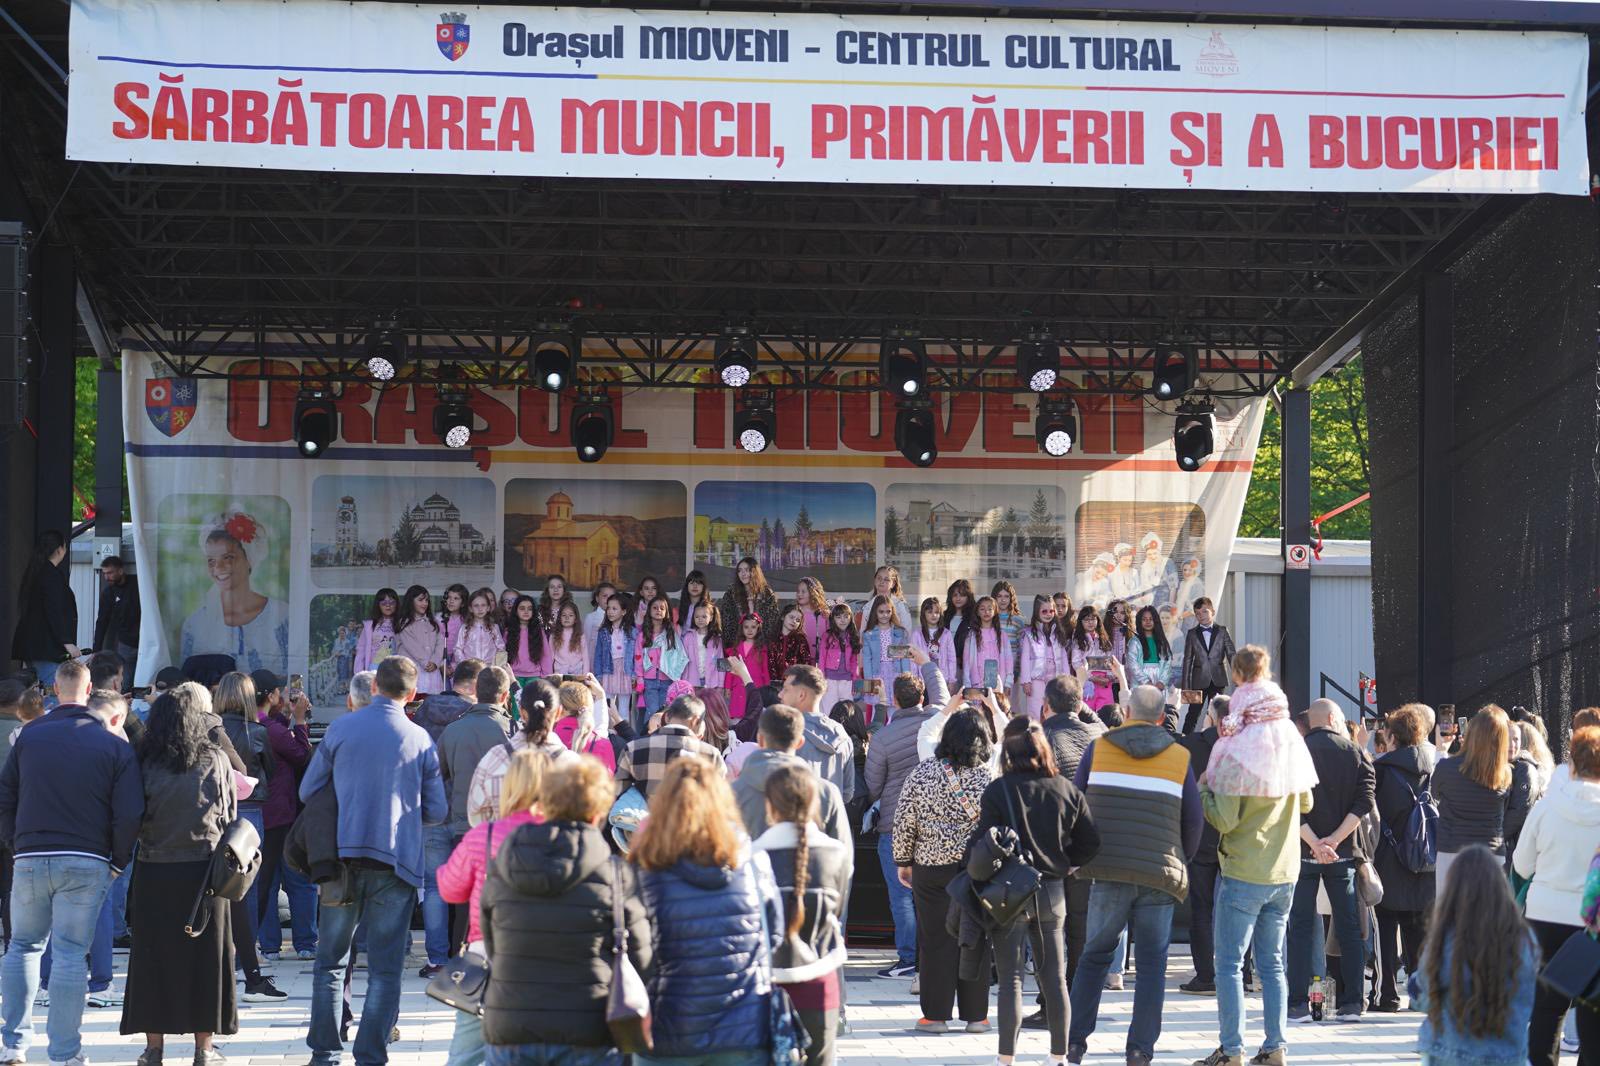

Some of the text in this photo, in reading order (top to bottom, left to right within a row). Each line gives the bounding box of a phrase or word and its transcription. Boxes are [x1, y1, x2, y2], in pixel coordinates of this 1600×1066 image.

[503, 22, 623, 68] Orașul
[640, 25, 789, 62] MIOVENI
[836, 30, 990, 67] CENTRUL
[1004, 34, 1181, 72] CULTURAL
[112, 72, 1559, 183] SĂRBĂTOAREA MUNCII, PRIMĂVERII ȘI A BUCURIEI
